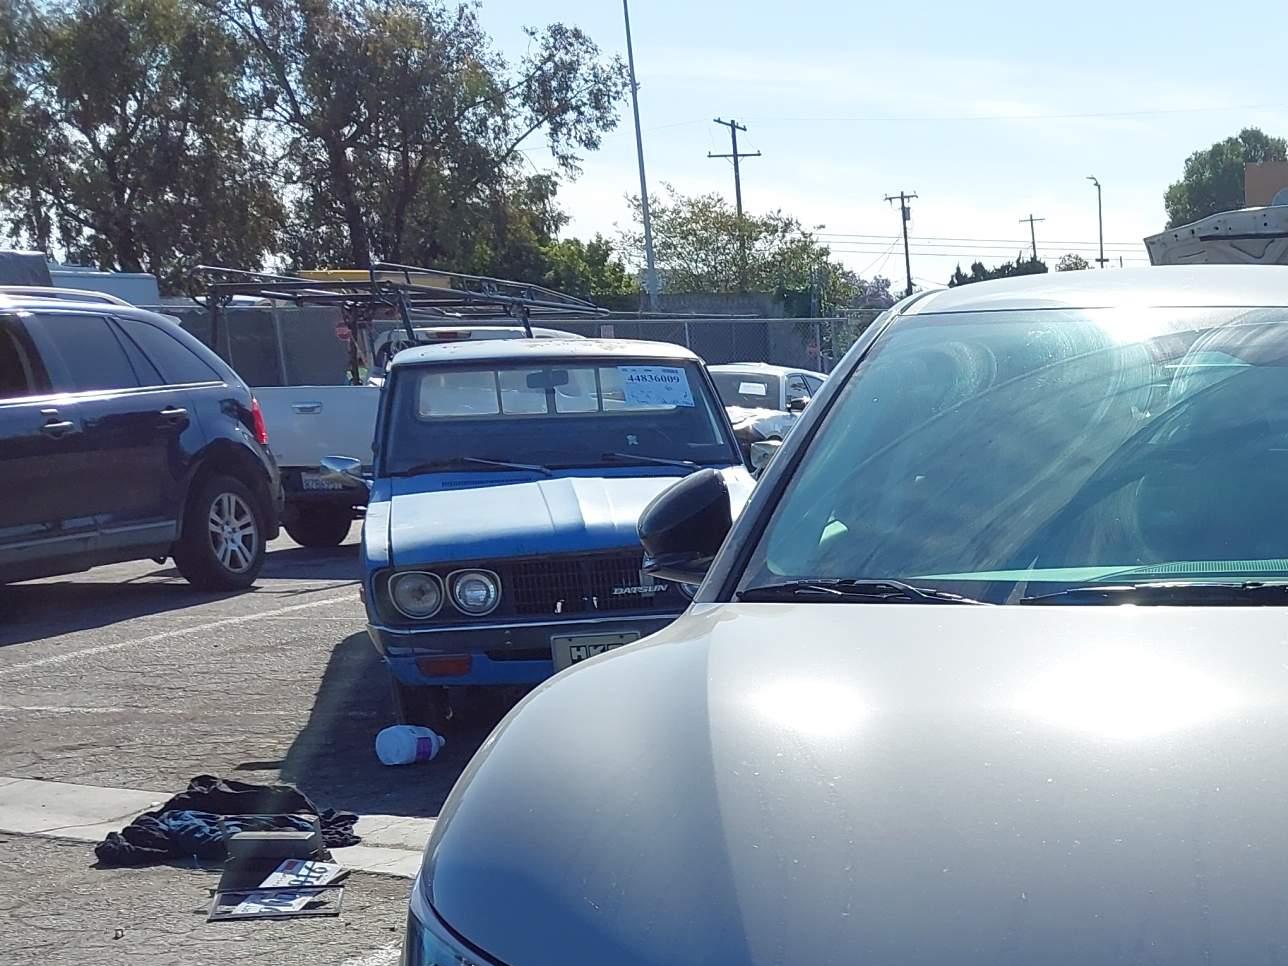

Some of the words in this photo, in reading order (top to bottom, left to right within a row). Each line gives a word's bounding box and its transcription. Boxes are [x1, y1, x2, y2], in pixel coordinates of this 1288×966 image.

[627, 374, 680, 383] 44836009
[612, 584, 669, 595] DATSUN
[569, 643, 625, 664] HK
